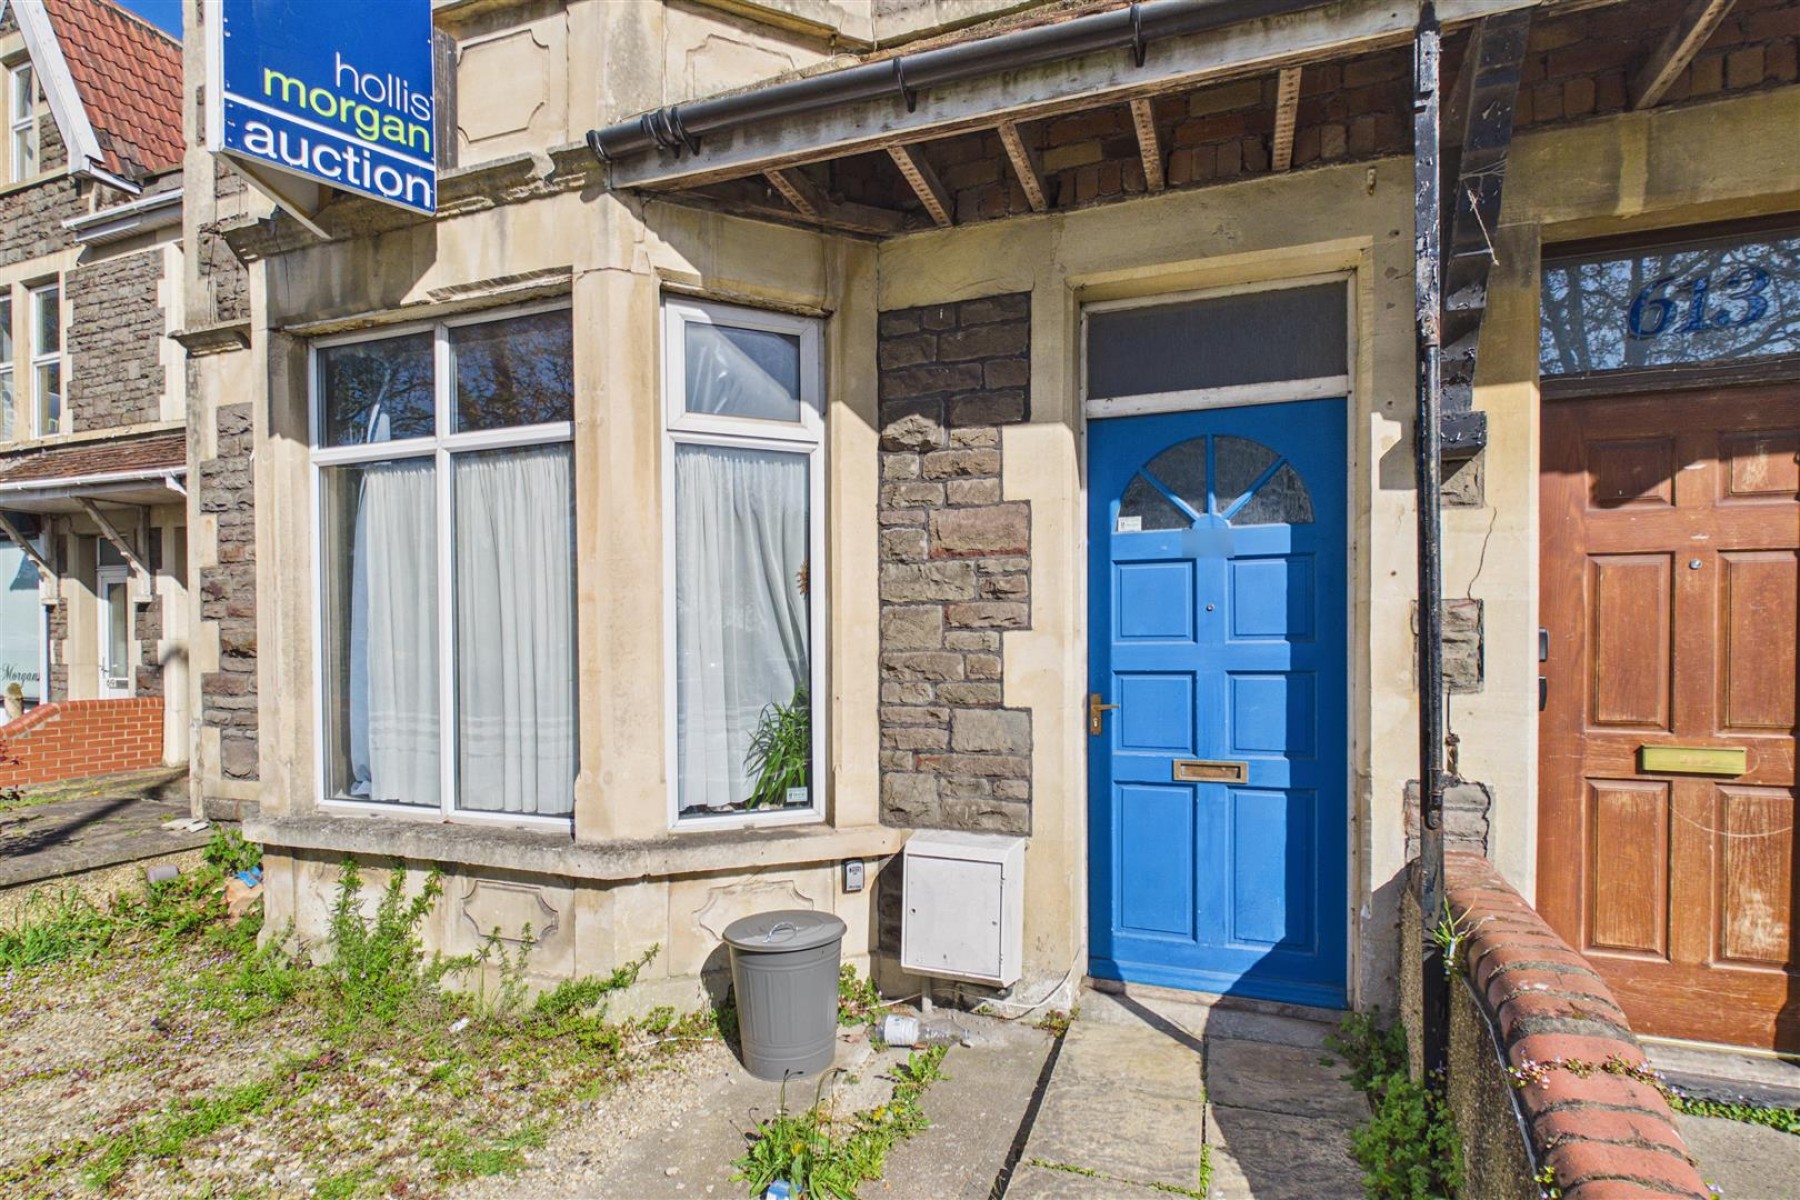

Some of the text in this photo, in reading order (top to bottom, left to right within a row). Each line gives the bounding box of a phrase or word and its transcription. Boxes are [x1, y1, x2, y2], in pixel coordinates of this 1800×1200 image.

[263, 67, 430, 153] morgan
[335, 51, 430, 121] hollis
[243, 121, 431, 207] auction
[1627, 266, 1771, 340] 613
